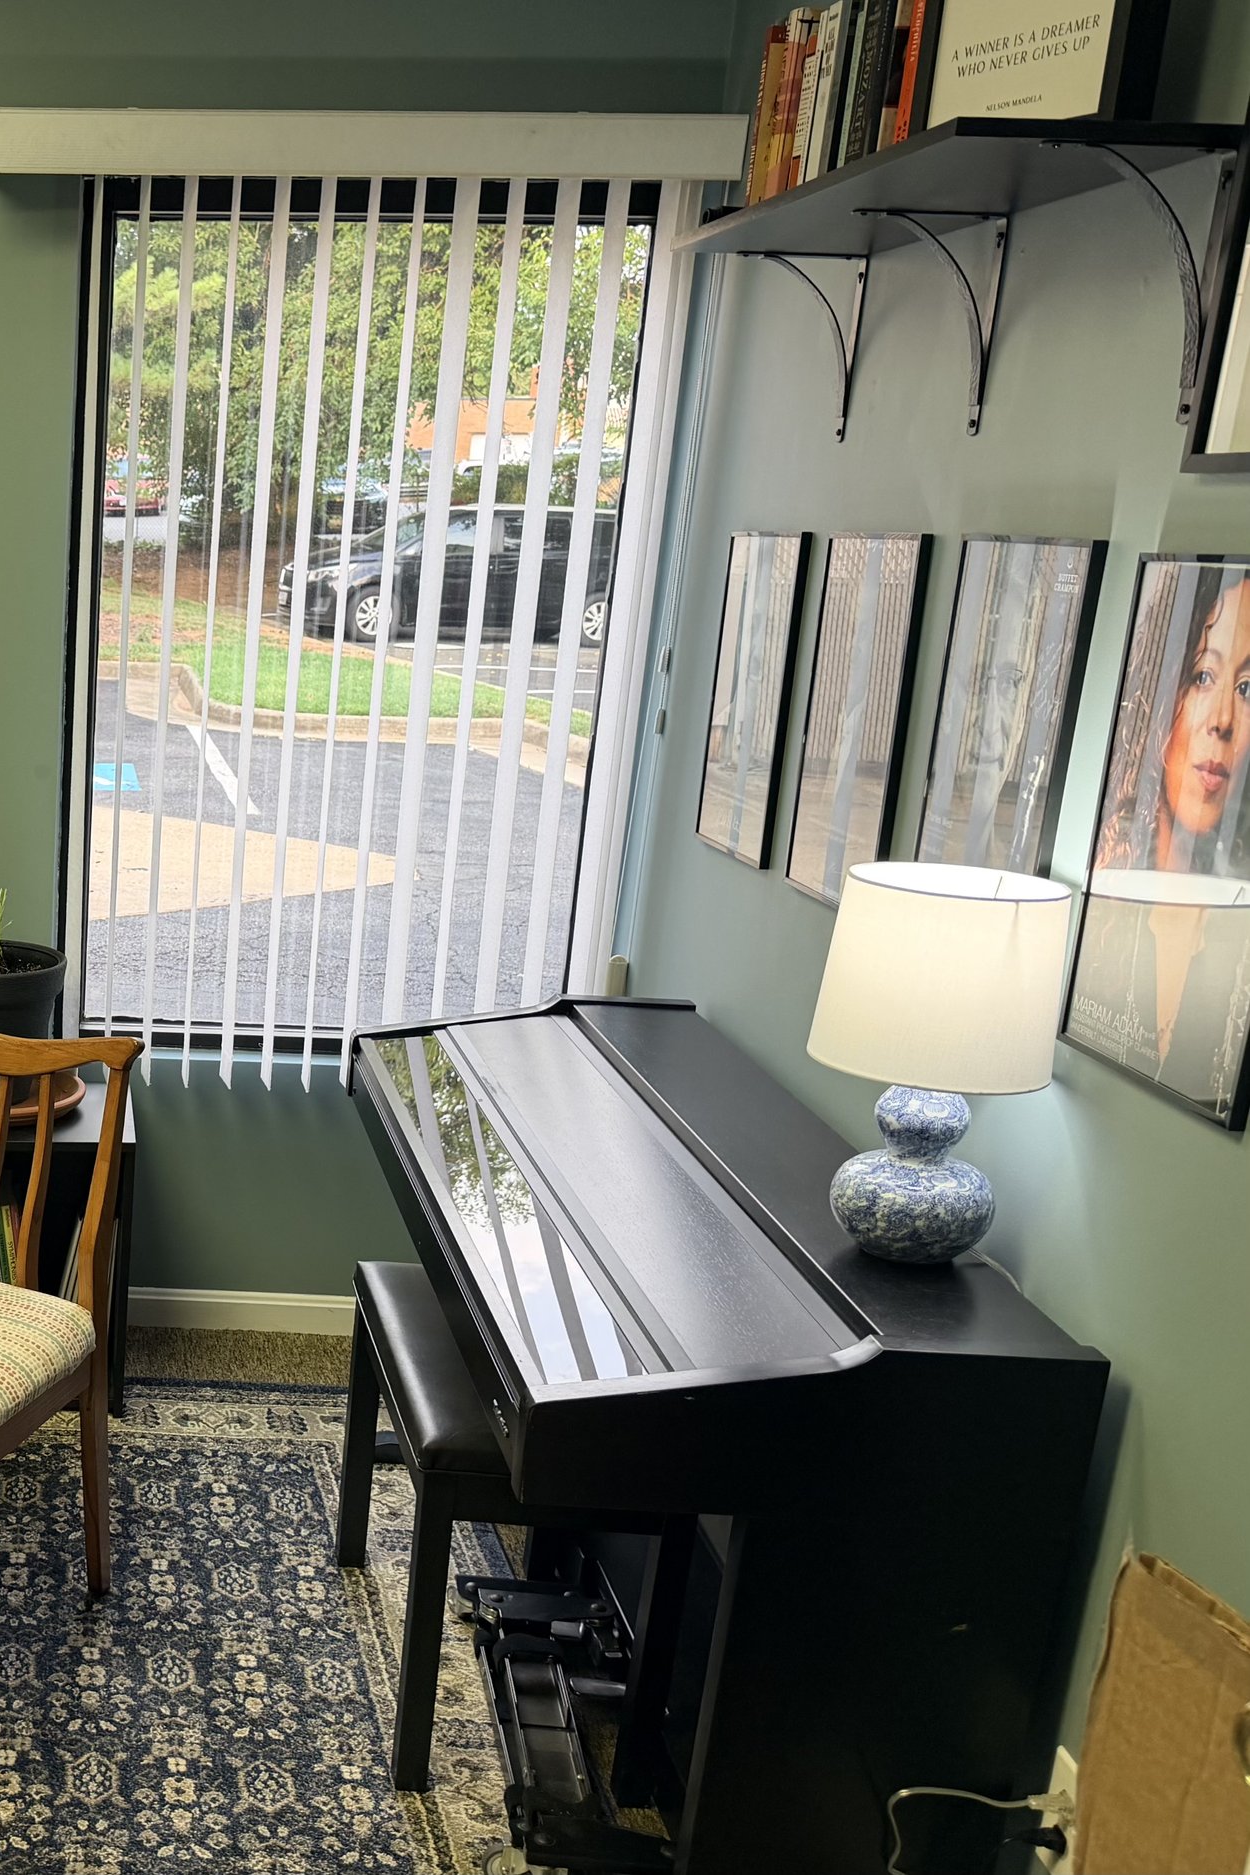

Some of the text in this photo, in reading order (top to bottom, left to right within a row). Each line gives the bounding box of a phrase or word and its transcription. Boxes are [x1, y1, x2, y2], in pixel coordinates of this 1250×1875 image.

[951, 13, 1100, 63] A WINNER IS A DREAMER
[957, 35, 1090, 78] WHO NEVER GIVES UP
[854, 49, 875, 128] MOZART
[985, 94, 1043, 112] NELSON MANDELA
[1073, 993, 1112, 1025] MARIAM
